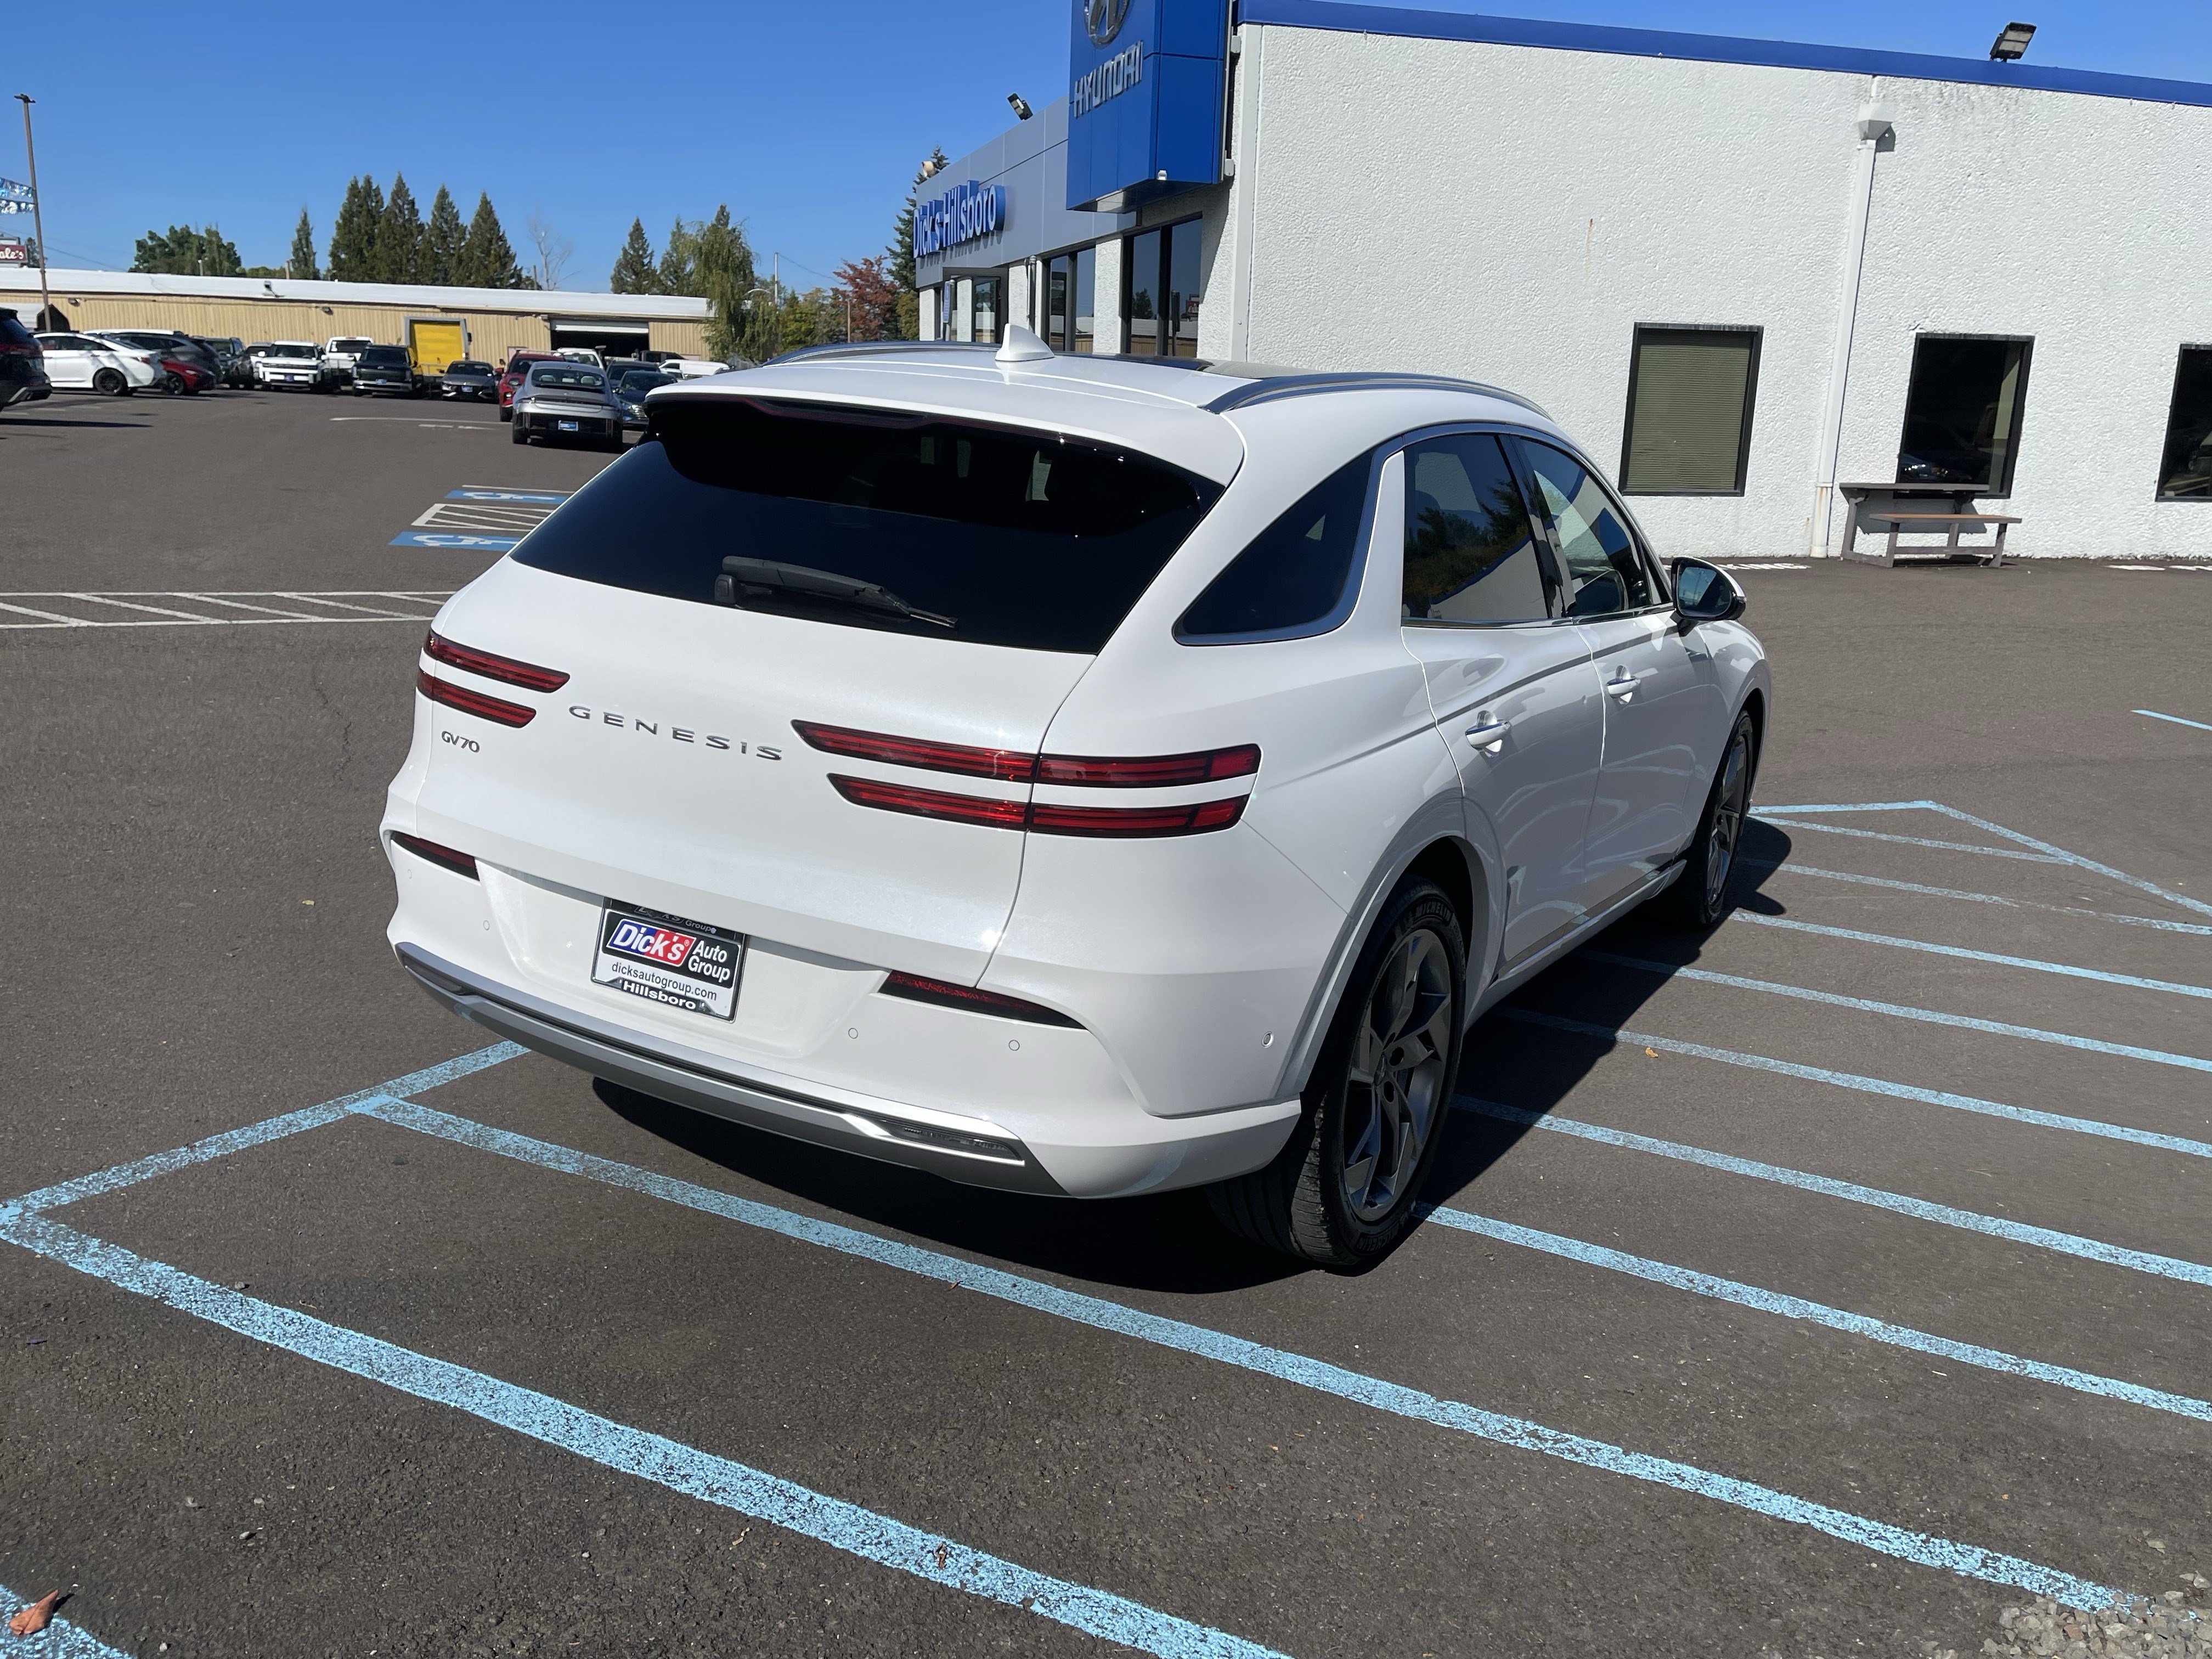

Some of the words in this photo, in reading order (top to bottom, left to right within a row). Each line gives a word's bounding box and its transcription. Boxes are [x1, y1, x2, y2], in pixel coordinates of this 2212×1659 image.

[1074, 40, 1143, 118] HYUNDAI
[913, 200, 941, 258] Dick's
[943, 180, 998, 247] Hillsboro
[441, 730, 481, 753] GV70
[568, 705, 783, 761] GENESIS
[613, 924, 685, 961] Dick's
[692, 940, 727, 963] Auto
[612, 962, 717, 1001] dicksautogroup.com
[688, 956, 730, 983] Group
[623, 980, 696, 1010] Hillsboro
